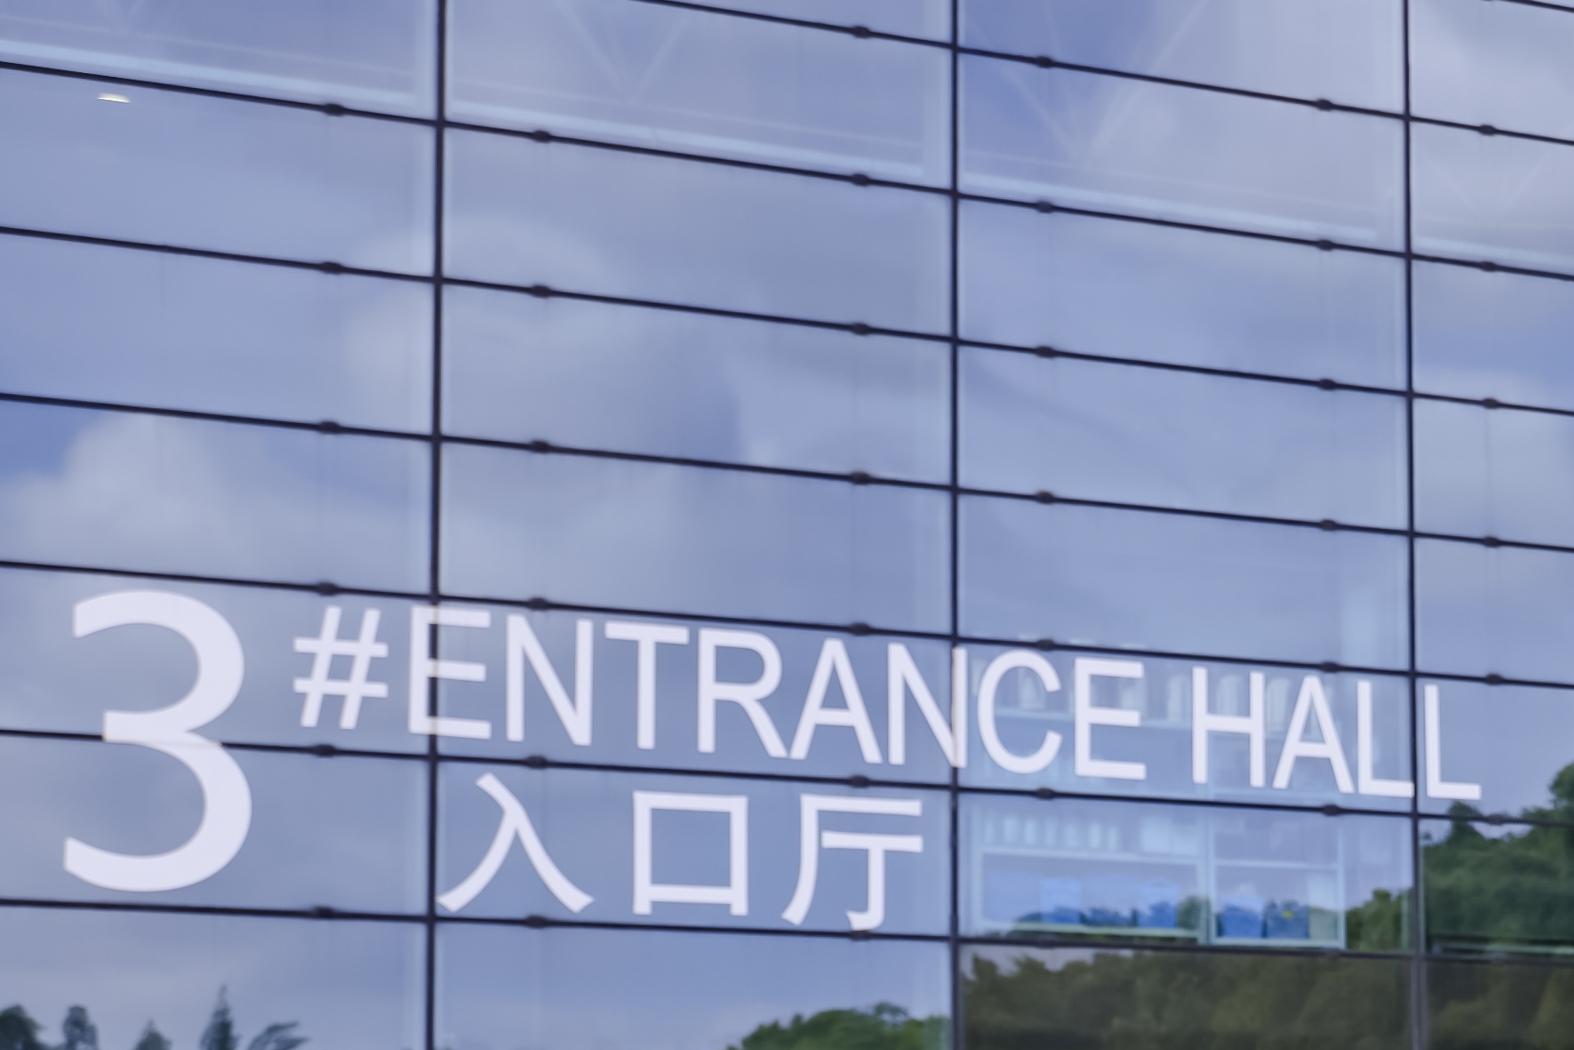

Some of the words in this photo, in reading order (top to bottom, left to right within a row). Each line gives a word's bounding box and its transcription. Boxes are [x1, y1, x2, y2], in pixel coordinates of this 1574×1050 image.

[64, 590, 252, 892] 3
[1192, 665, 1482, 800] HALL
[435, 772, 924, 931] 入口厅
